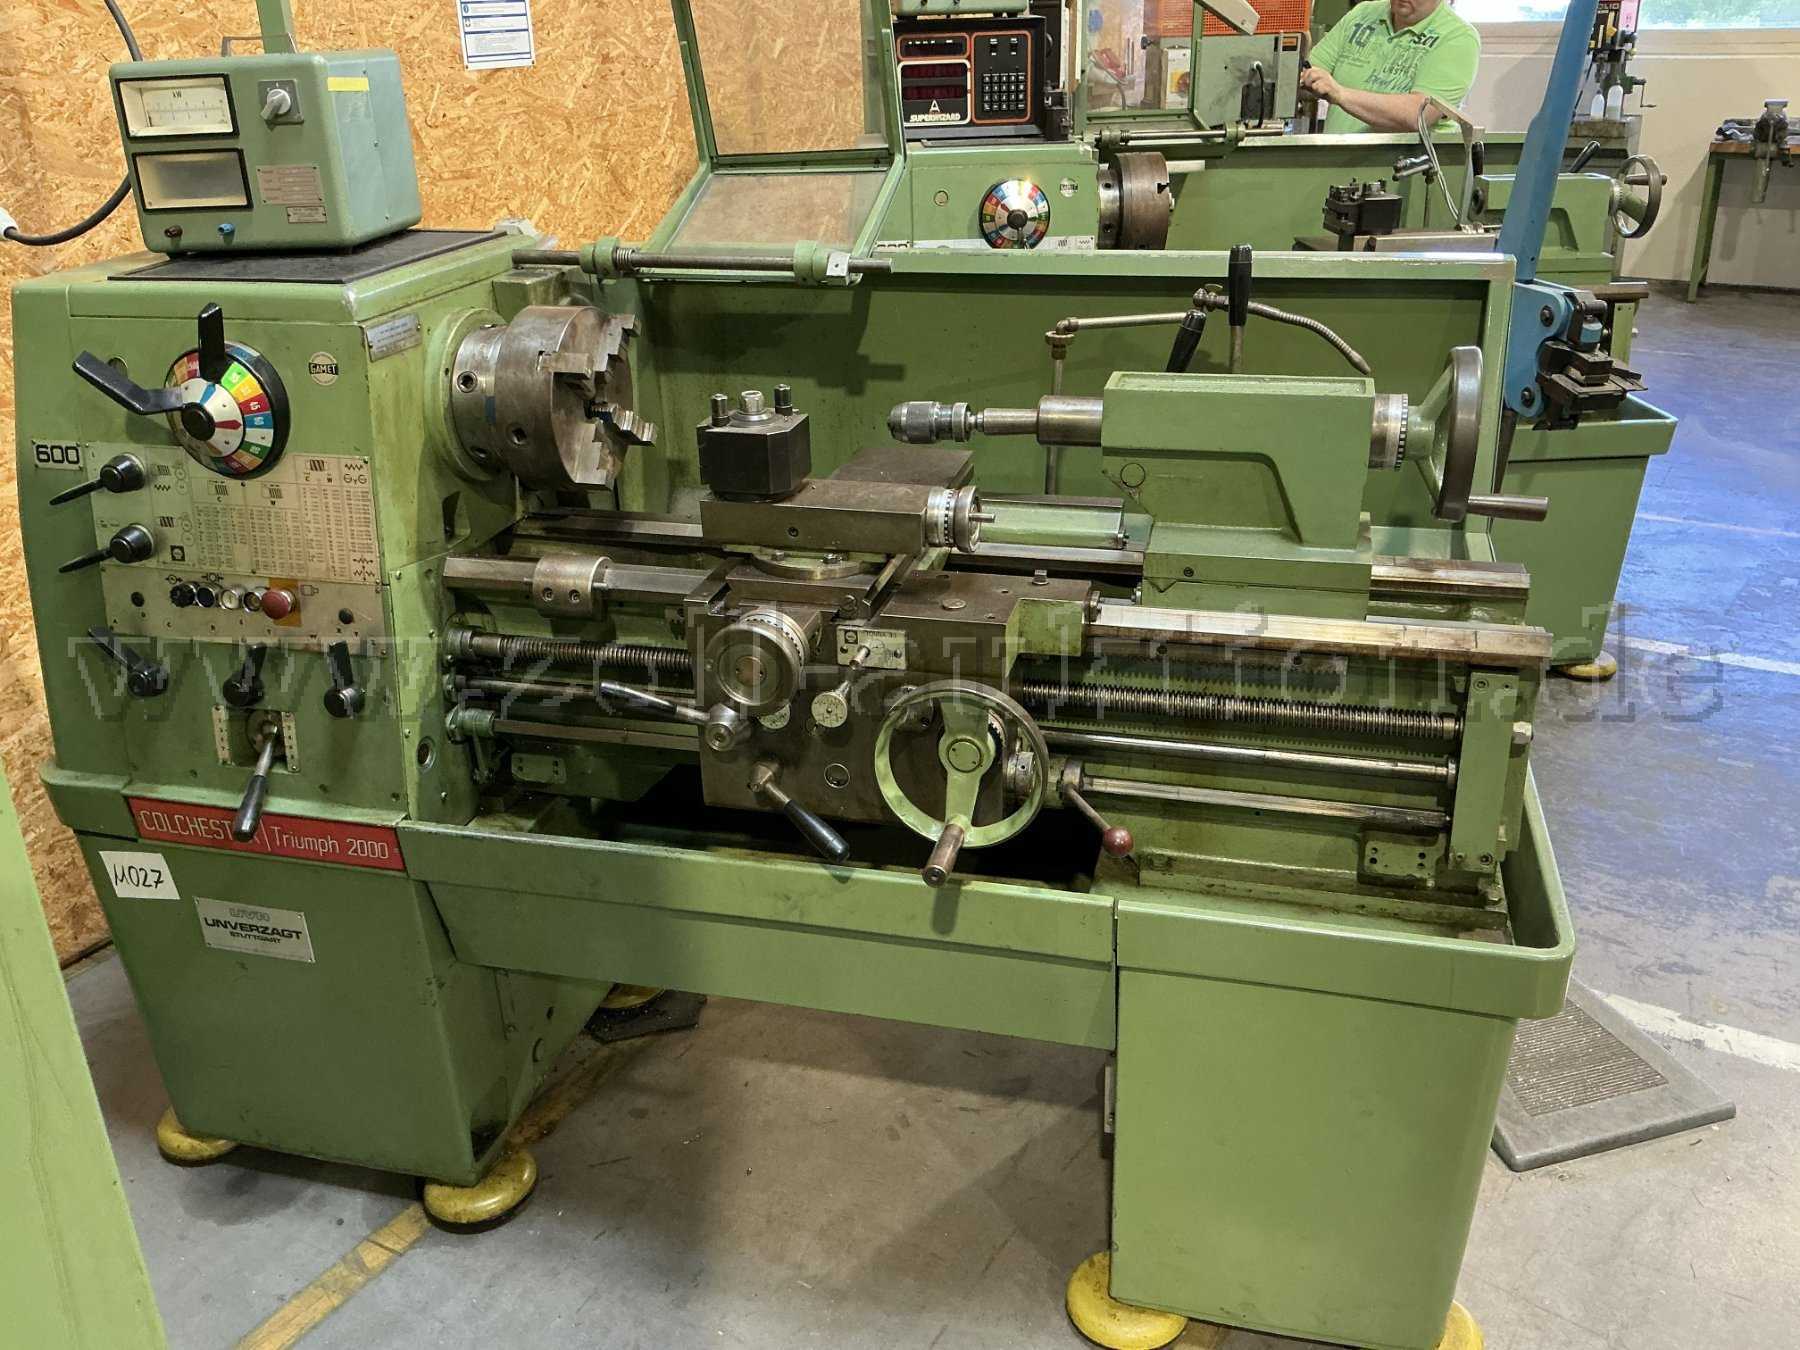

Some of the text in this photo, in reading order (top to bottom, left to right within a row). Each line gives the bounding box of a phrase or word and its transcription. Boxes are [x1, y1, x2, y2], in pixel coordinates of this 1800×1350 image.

[310, 363, 336, 375] GAMET
[35, 444, 80, 465] 600
[140, 810, 389, 860] COLCHEST Triumph 2000
[204, 917, 302, 940] UNVERZAGT
